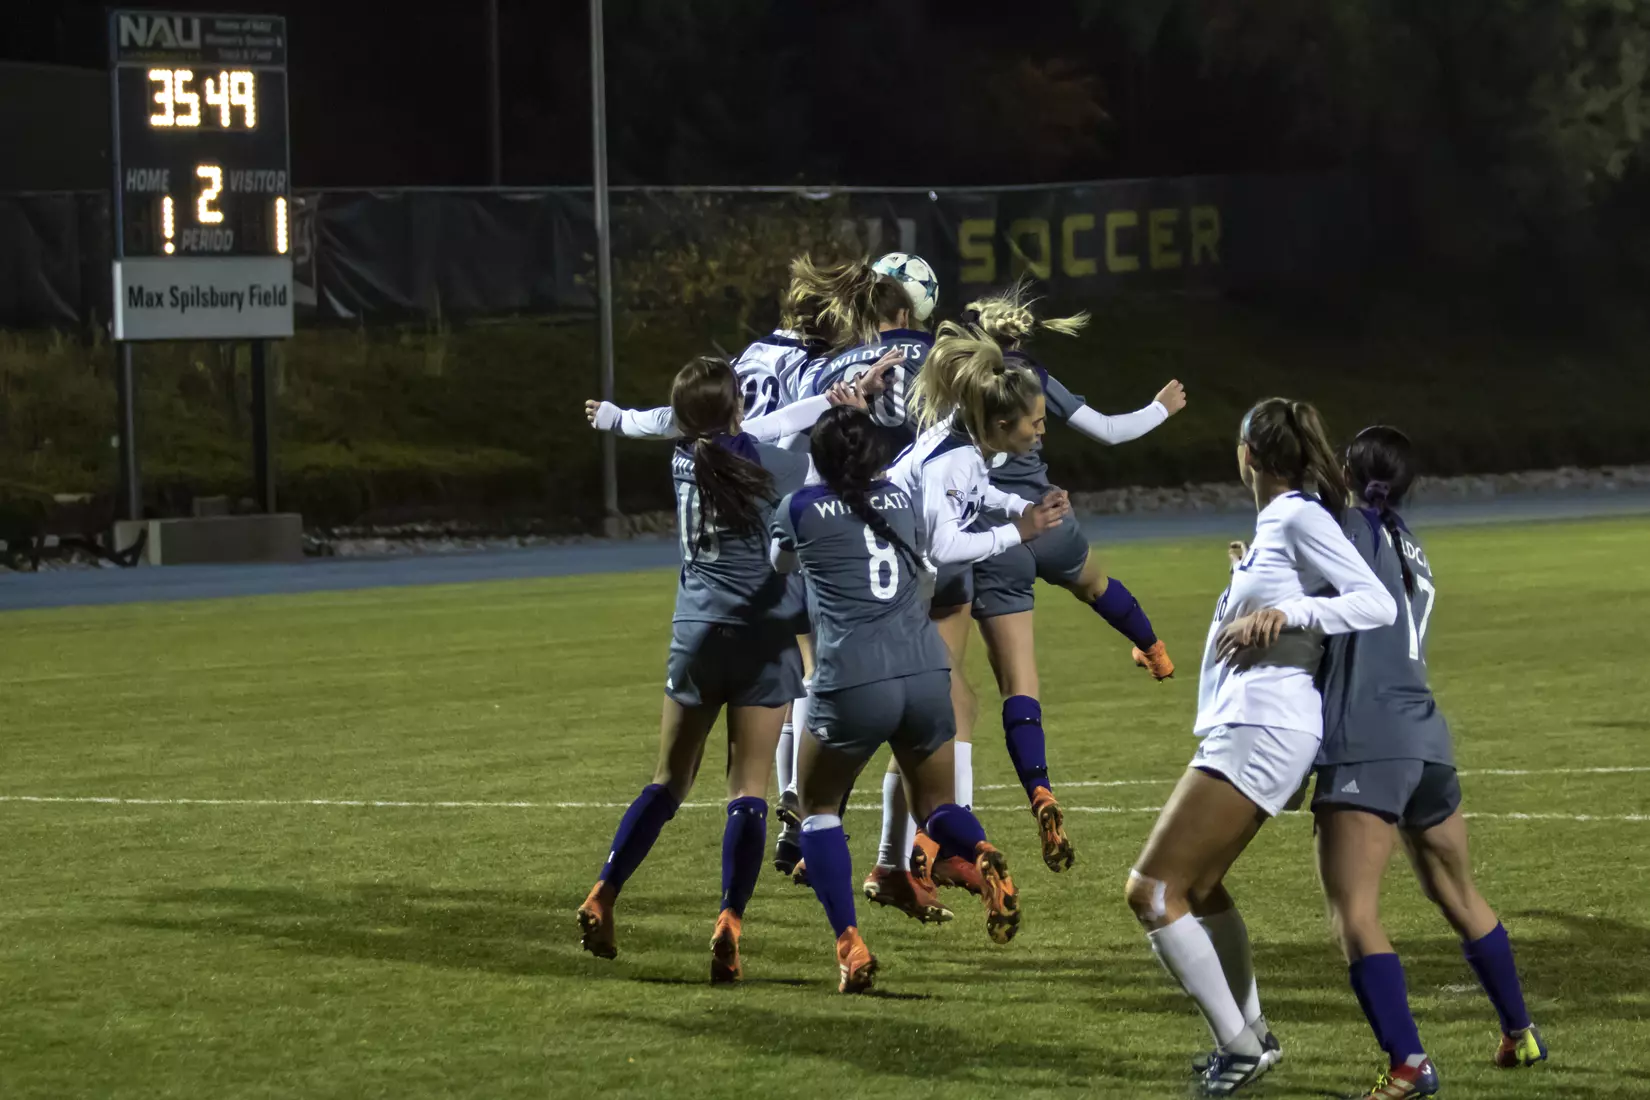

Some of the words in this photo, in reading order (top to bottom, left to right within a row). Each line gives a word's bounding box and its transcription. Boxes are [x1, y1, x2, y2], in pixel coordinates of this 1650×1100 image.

[119, 15, 201, 48] NAU
[126, 169, 170, 192] HOME
[196, 165, 224, 223] 2
[230, 170, 287, 193] VISITOR
[182, 229, 234, 252] PERIOD
[276, 197, 288, 254] 1
[958, 205, 1221, 283] SOCCER
[128, 285, 164, 309] Max
[169, 285, 245, 314] Spilsbury
[249, 284, 287, 308] Field
